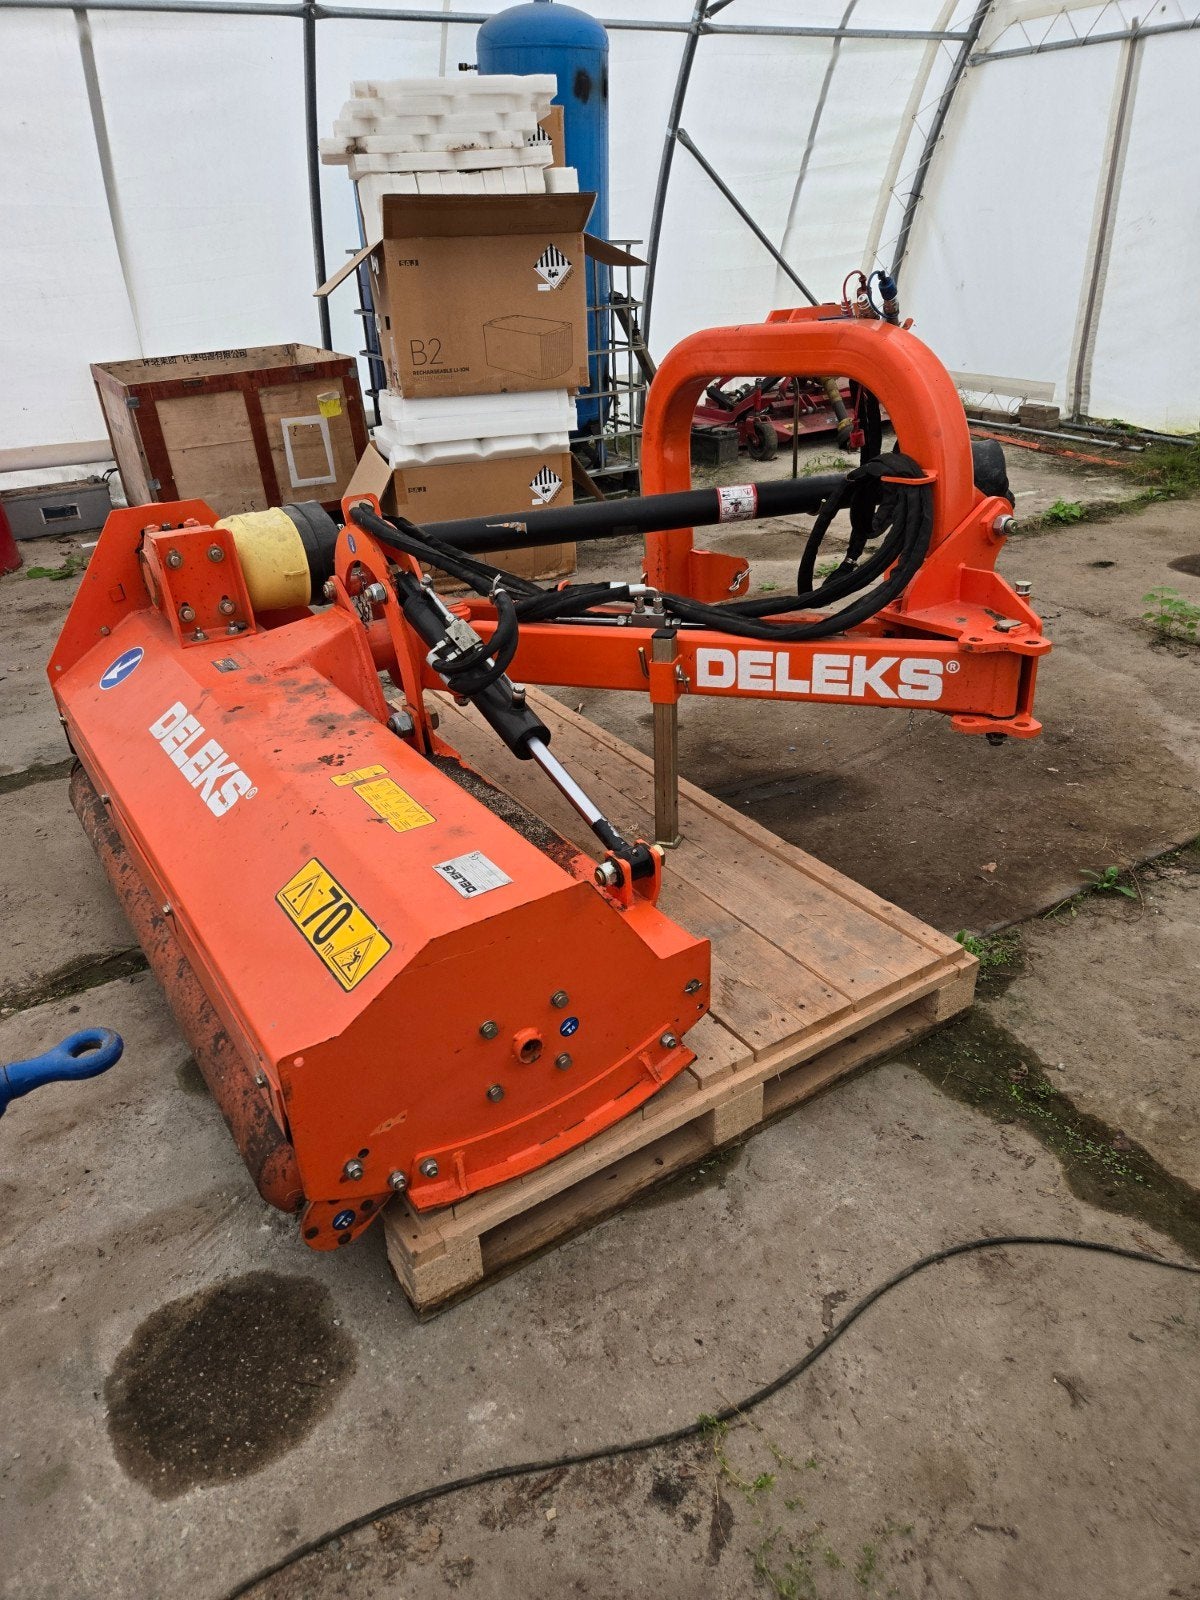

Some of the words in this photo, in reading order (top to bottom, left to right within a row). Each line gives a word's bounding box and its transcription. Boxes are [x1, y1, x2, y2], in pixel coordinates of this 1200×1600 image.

[410, 338, 443, 365] B2
[442, 865, 477, 893] DELEKS
[301, 886, 353, 945] 70
